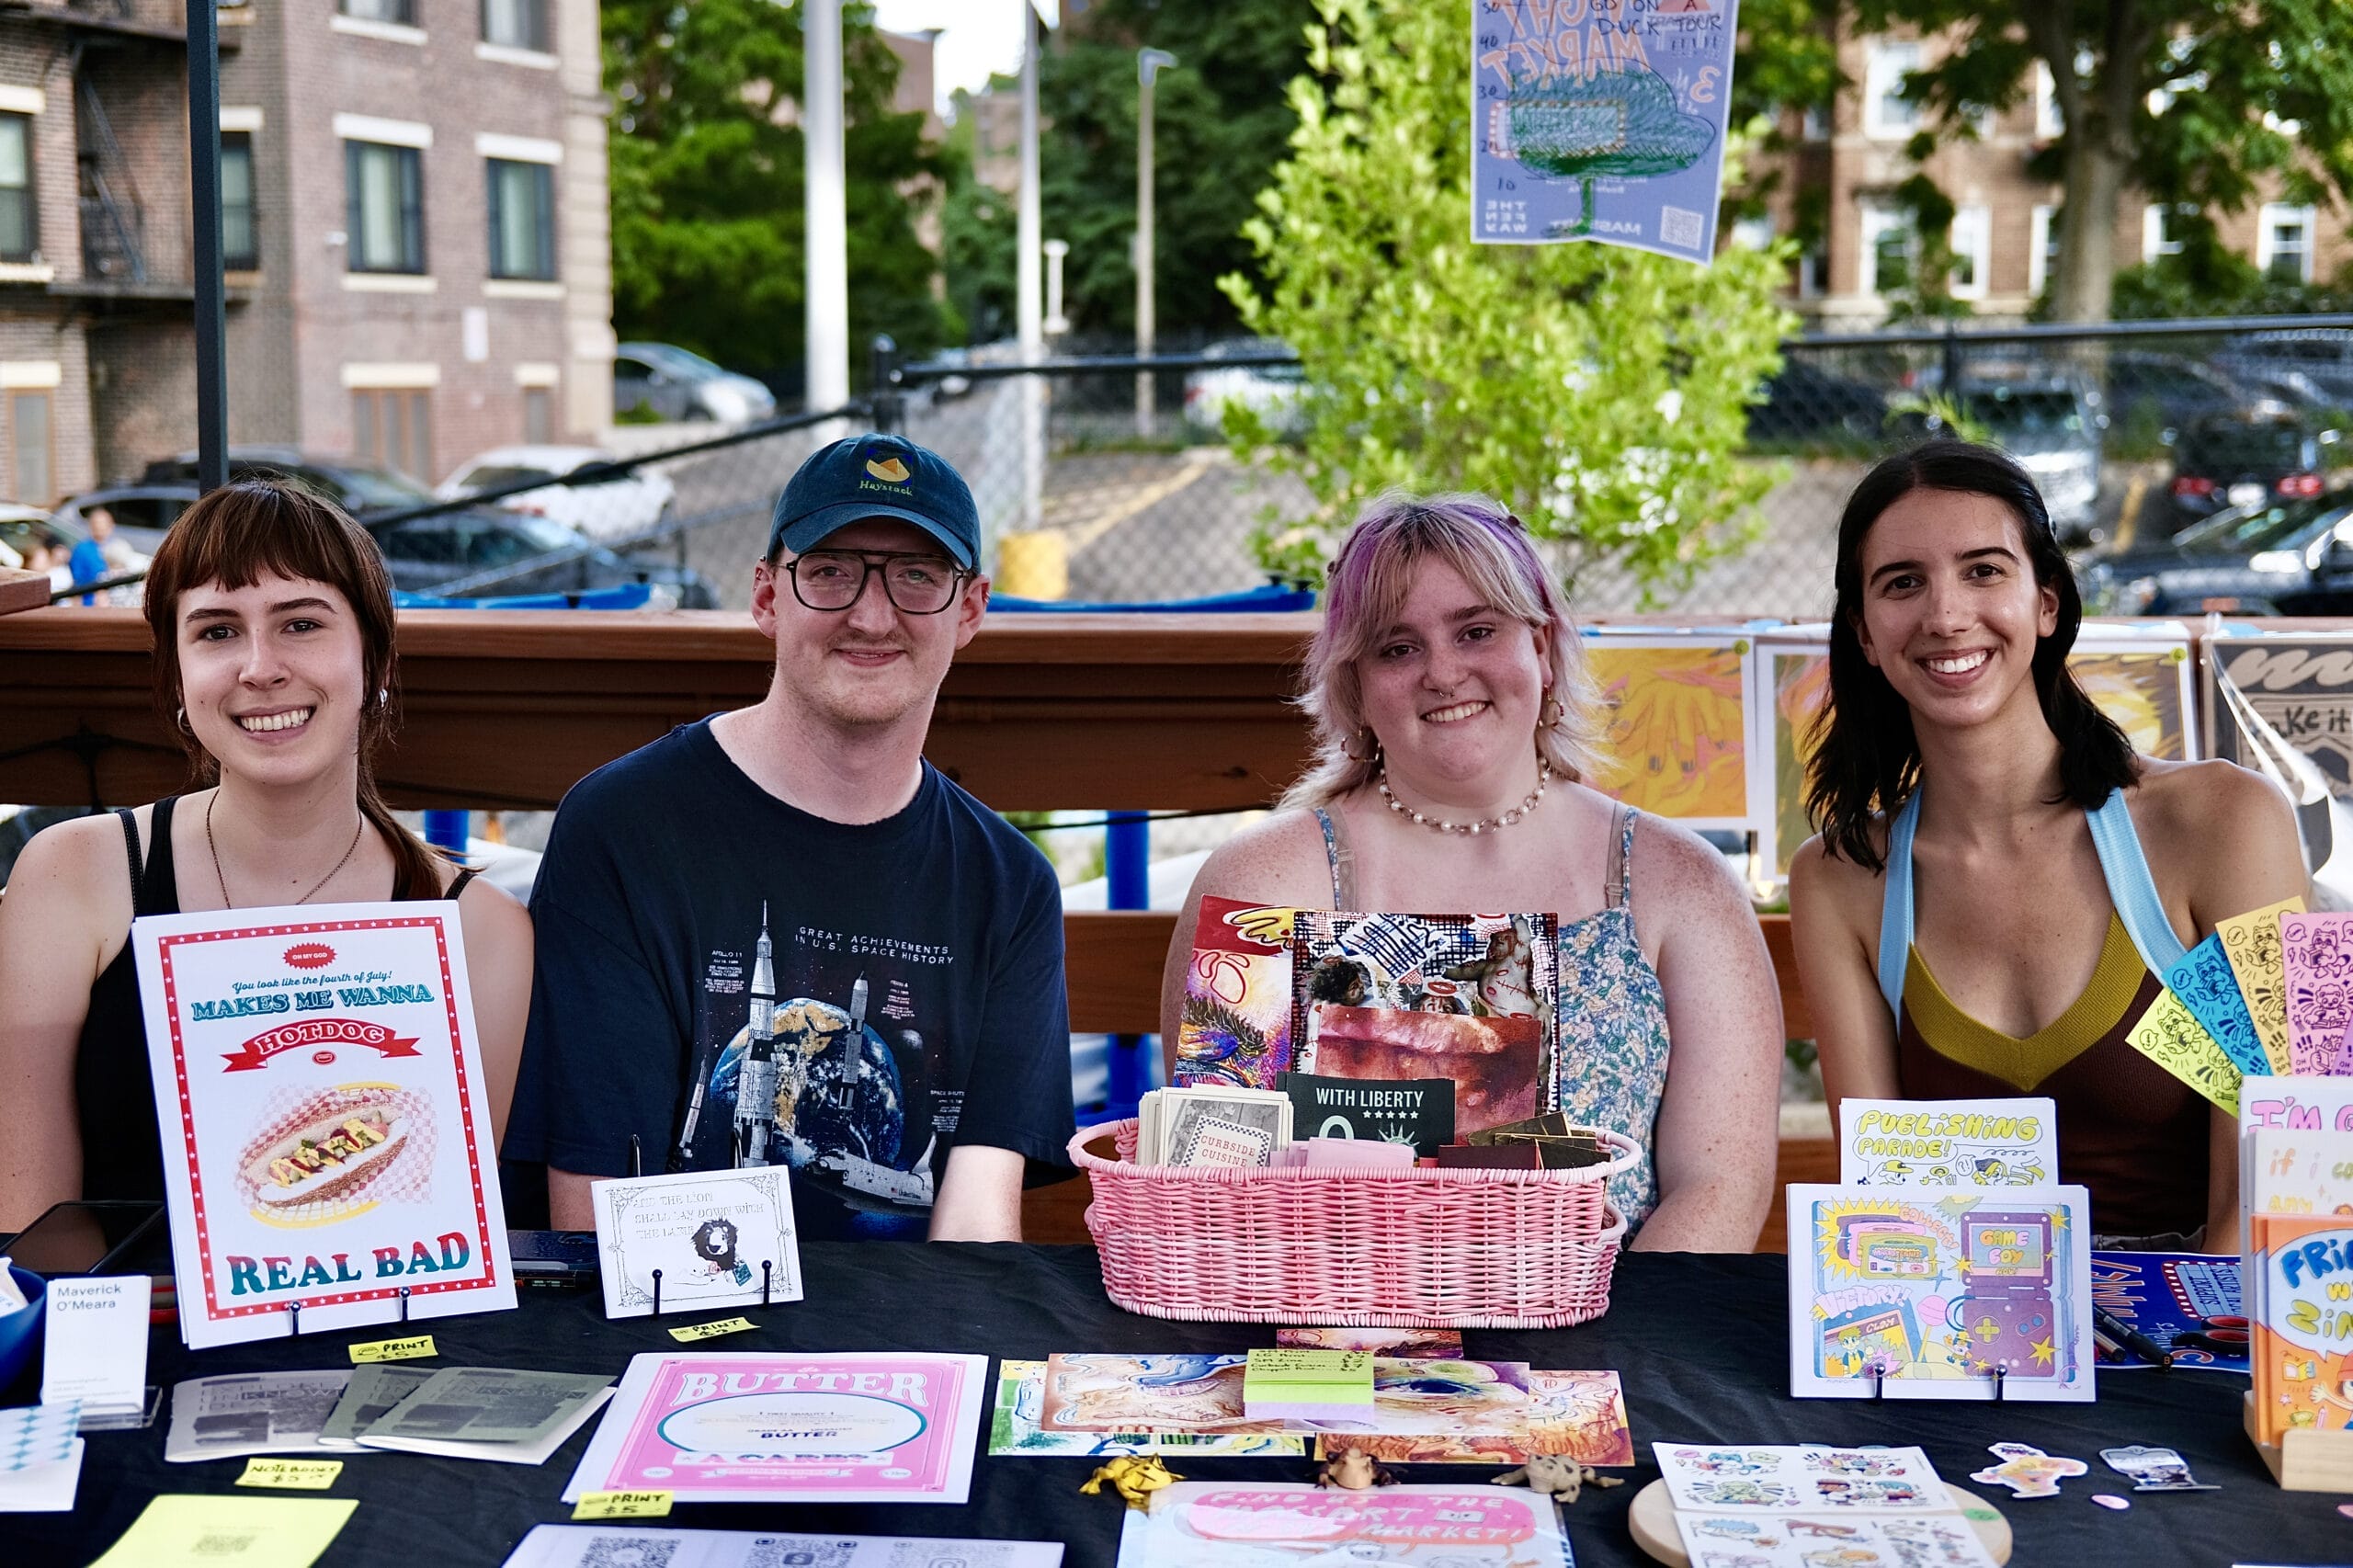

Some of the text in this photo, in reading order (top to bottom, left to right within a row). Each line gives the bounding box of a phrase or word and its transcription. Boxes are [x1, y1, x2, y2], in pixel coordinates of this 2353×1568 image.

[1598, 18, 1660, 36] DUCK
[1674, 14, 1722, 32] TOUR
[859, 480, 913, 496] Haystack
[2328, 709, 2349, 733] it
[795, 934, 954, 964] IN U.S. SPACE HISTORY
[800, 926, 949, 955] GREAT ACHIEVEMENTS
[232, 970, 392, 994] You look like the fourth of July!
[191, 983, 435, 1022] MAKES ME WANNA
[254, 1021, 386, 1056] HOTDOG
[1316, 1087, 1424, 1108] WITH LIBERTY
[2247, 1096, 2322, 1133] I'M
[1200, 1135, 1256, 1157] CURBSIDE
[1858, 1138, 1952, 1158] PARADE!
[1201, 1148, 1248, 1167] CUISINE
[2269, 1148, 2296, 1177] if
[698, 1205, 732, 1218] DOWN
[1979, 1230, 2029, 1246] GAME
[226, 1231, 471, 1296] REAL BAD
[57, 1283, 121, 1298] Maverick
[56, 1299, 116, 1312] O'Meara
[692, 1320, 739, 1332] PRINT
[383, 1339, 428, 1352] PRINT
[669, 1372, 928, 1407] BUTTER
[760, 1431, 838, 1439] BUTTER
[611, 1493, 665, 1503] PRINT
[1428, 1495, 1505, 1509] THE
